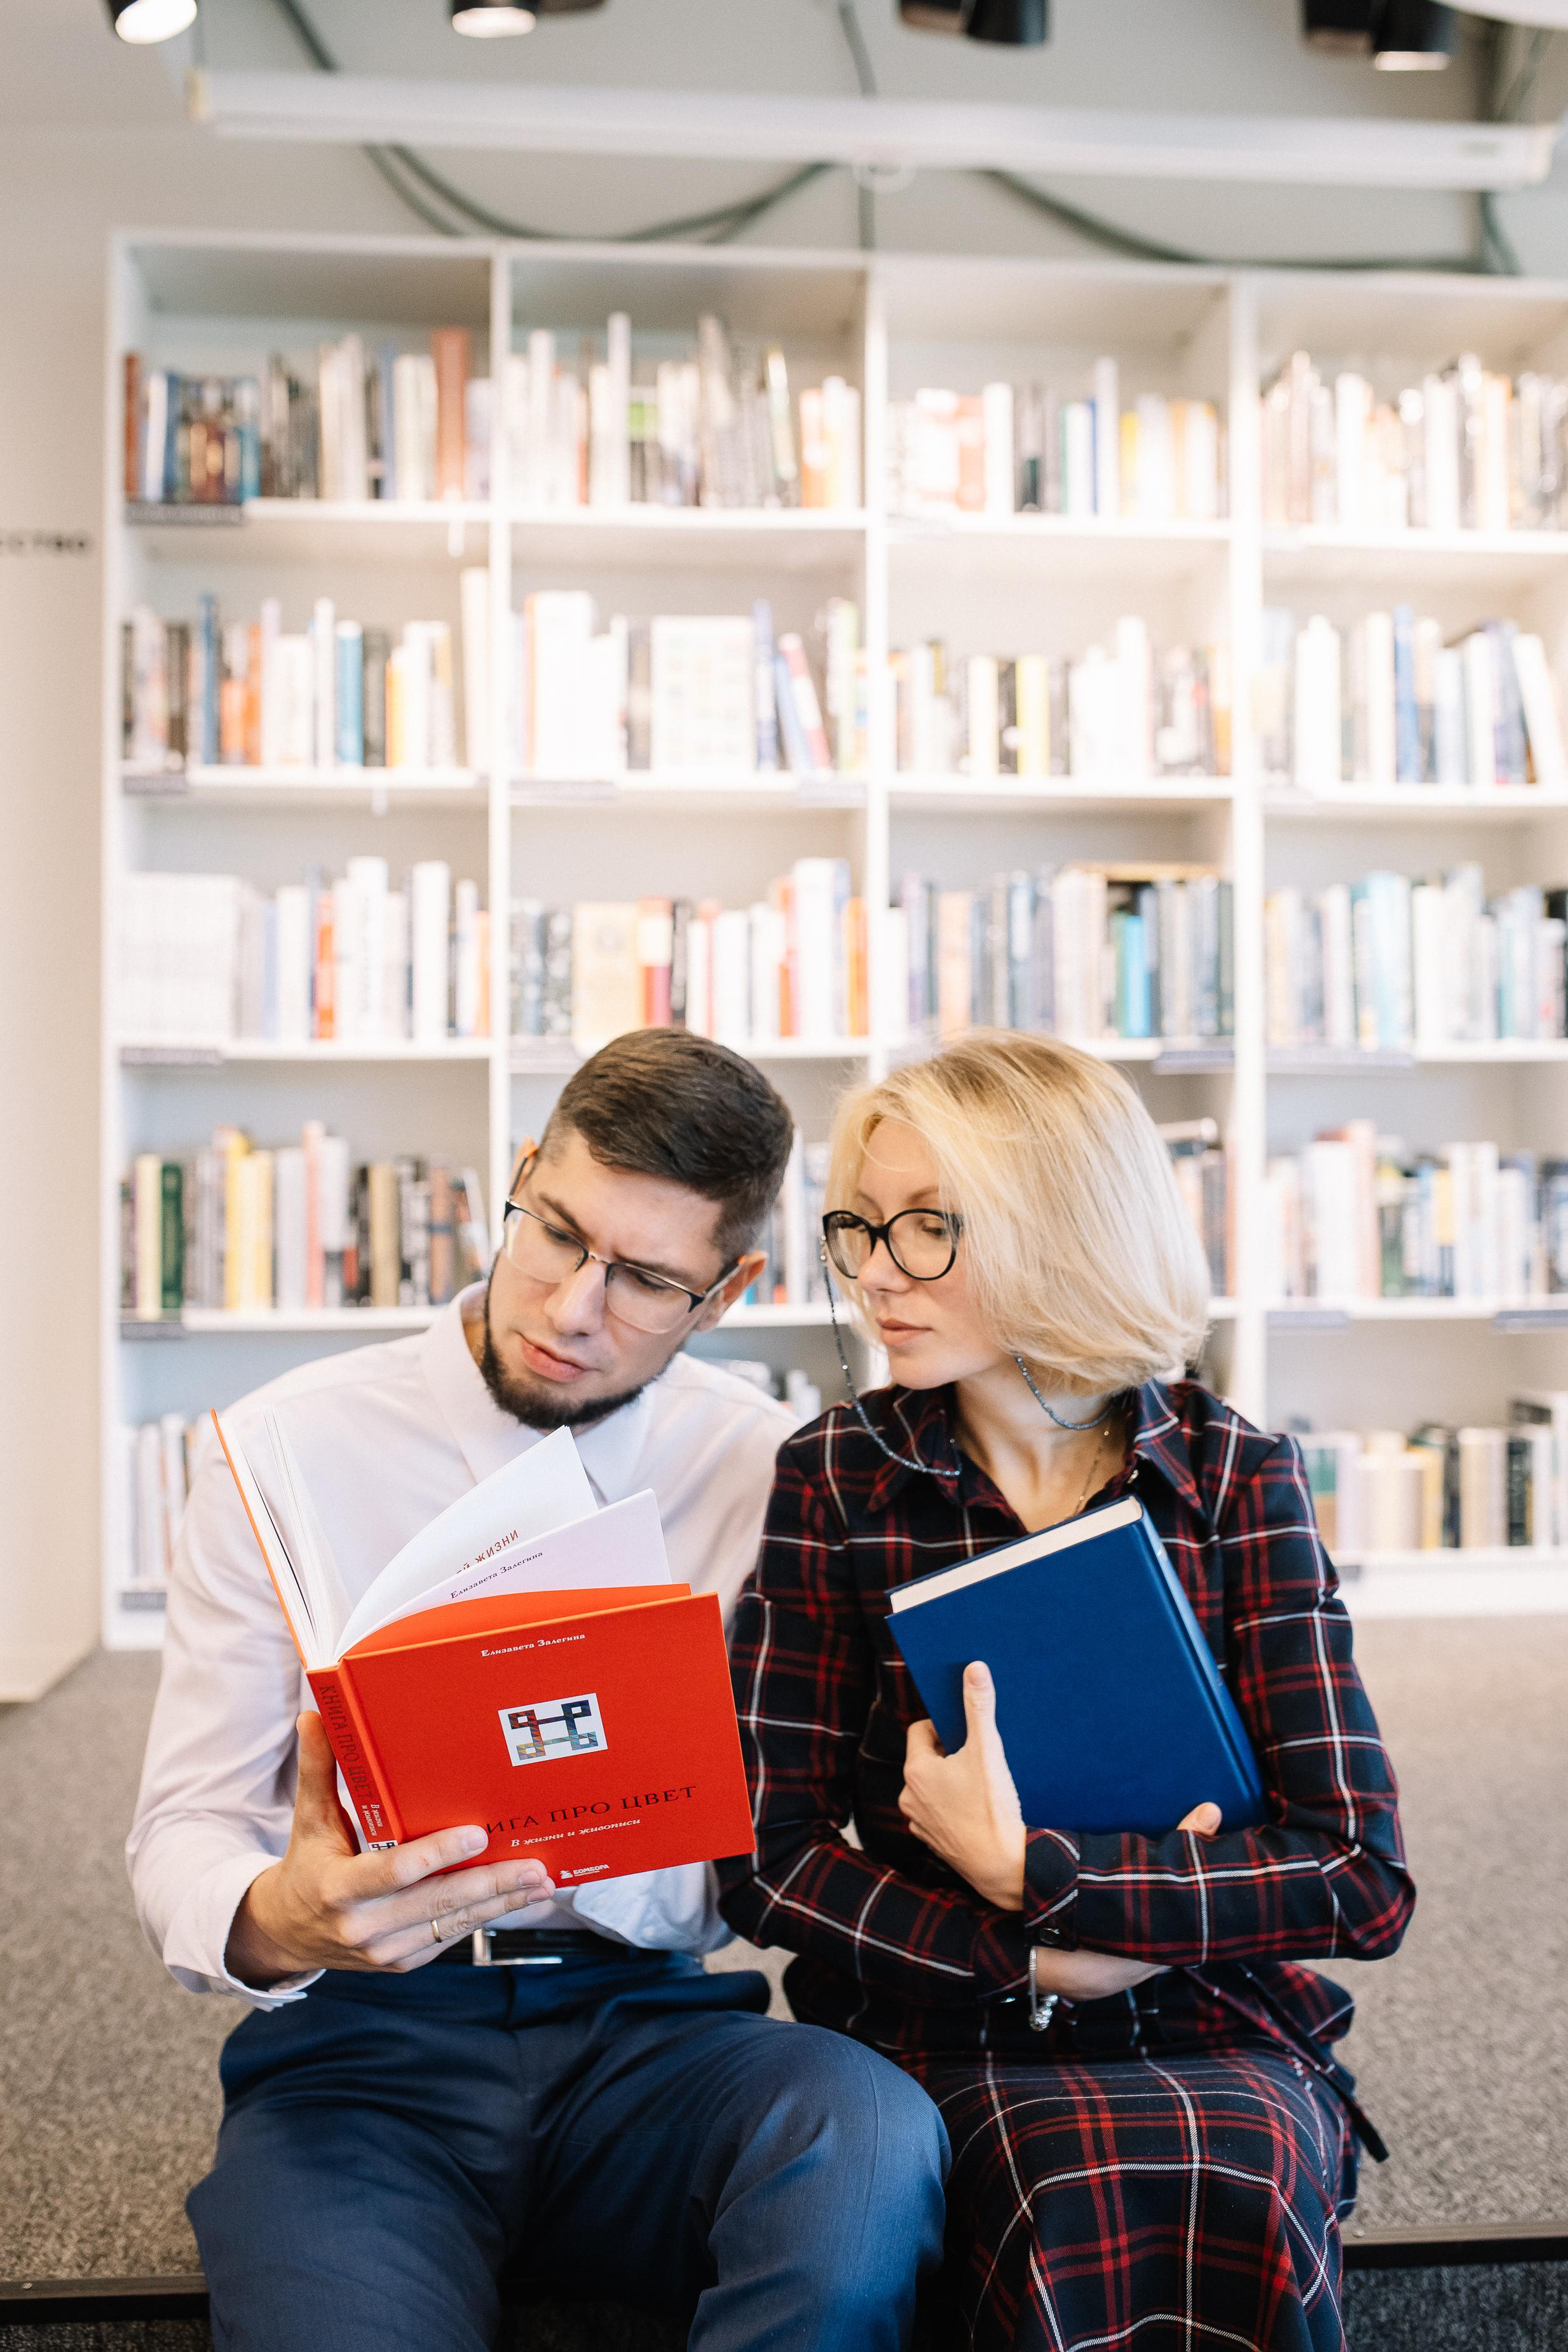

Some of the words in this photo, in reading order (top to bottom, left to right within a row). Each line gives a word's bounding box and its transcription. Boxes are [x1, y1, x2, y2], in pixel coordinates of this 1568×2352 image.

[474, 1529, 519, 1563] ЖИЗНИ
[451, 1573, 498, 1599] Елизавета
[500, 1552, 543, 1574] Залегина
[481, 1643, 535, 1657] Елизавета
[537, 1634, 586, 1647] Залегина
[320, 1685, 348, 1731] КНИГА
[337, 1733, 360, 1762] ПРО
[348, 1765, 374, 1798] ЦВЕТ
[486, 1815, 539, 1834] ИГА
[549, 1802, 611, 1823] ПРО
[620, 1785, 697, 1809] ЦВЕТ
[510, 1839, 520, 1847] В
[522, 1833, 564, 1845] жизни
[579, 1819, 641, 1835] живописи
[573, 1864, 610, 1875] БОМБОРА
